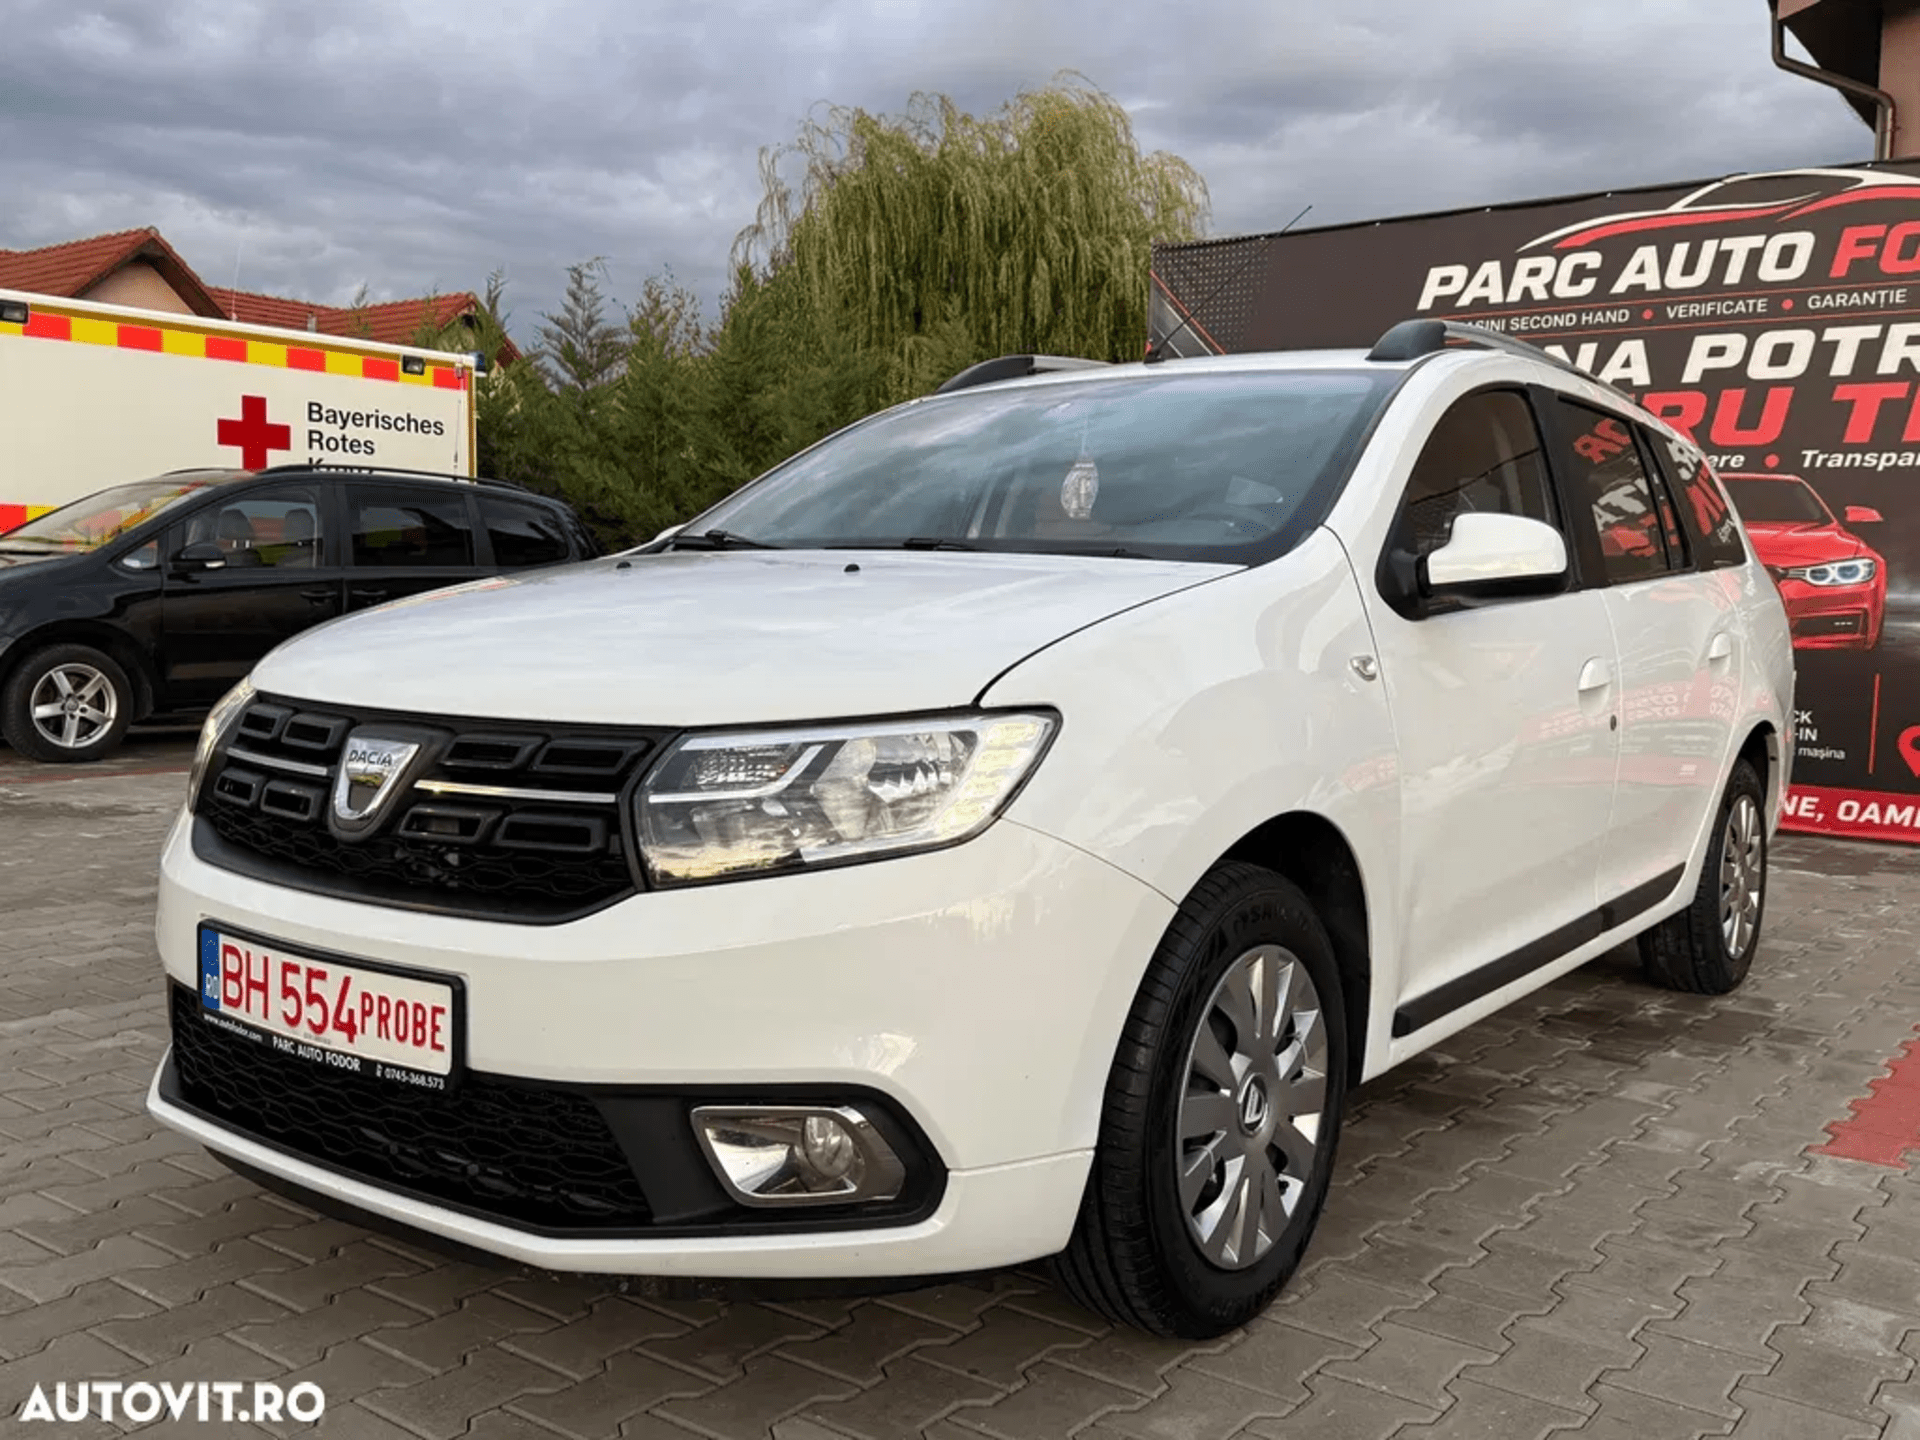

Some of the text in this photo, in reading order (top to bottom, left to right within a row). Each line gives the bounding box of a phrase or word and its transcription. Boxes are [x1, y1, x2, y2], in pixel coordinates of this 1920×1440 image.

[1416, 220, 1920, 311] PARC AUTO FO
[1509, 313, 1577, 332] SECOND
[1581, 309, 1630, 325] HAND
[1666, 298, 1768, 319] VERIFICATE
[307, 401, 444, 436] Bayerisches
[307, 430, 375, 455] Rotes
[348, 749, 393, 767] DACIA
[222, 943, 446, 1053] BH 554 PROBE
[272, 1035, 296, 1055] PARC
[297, 1044, 323, 1063] AUTO
[325, 1051, 361, 1072] FODOR
